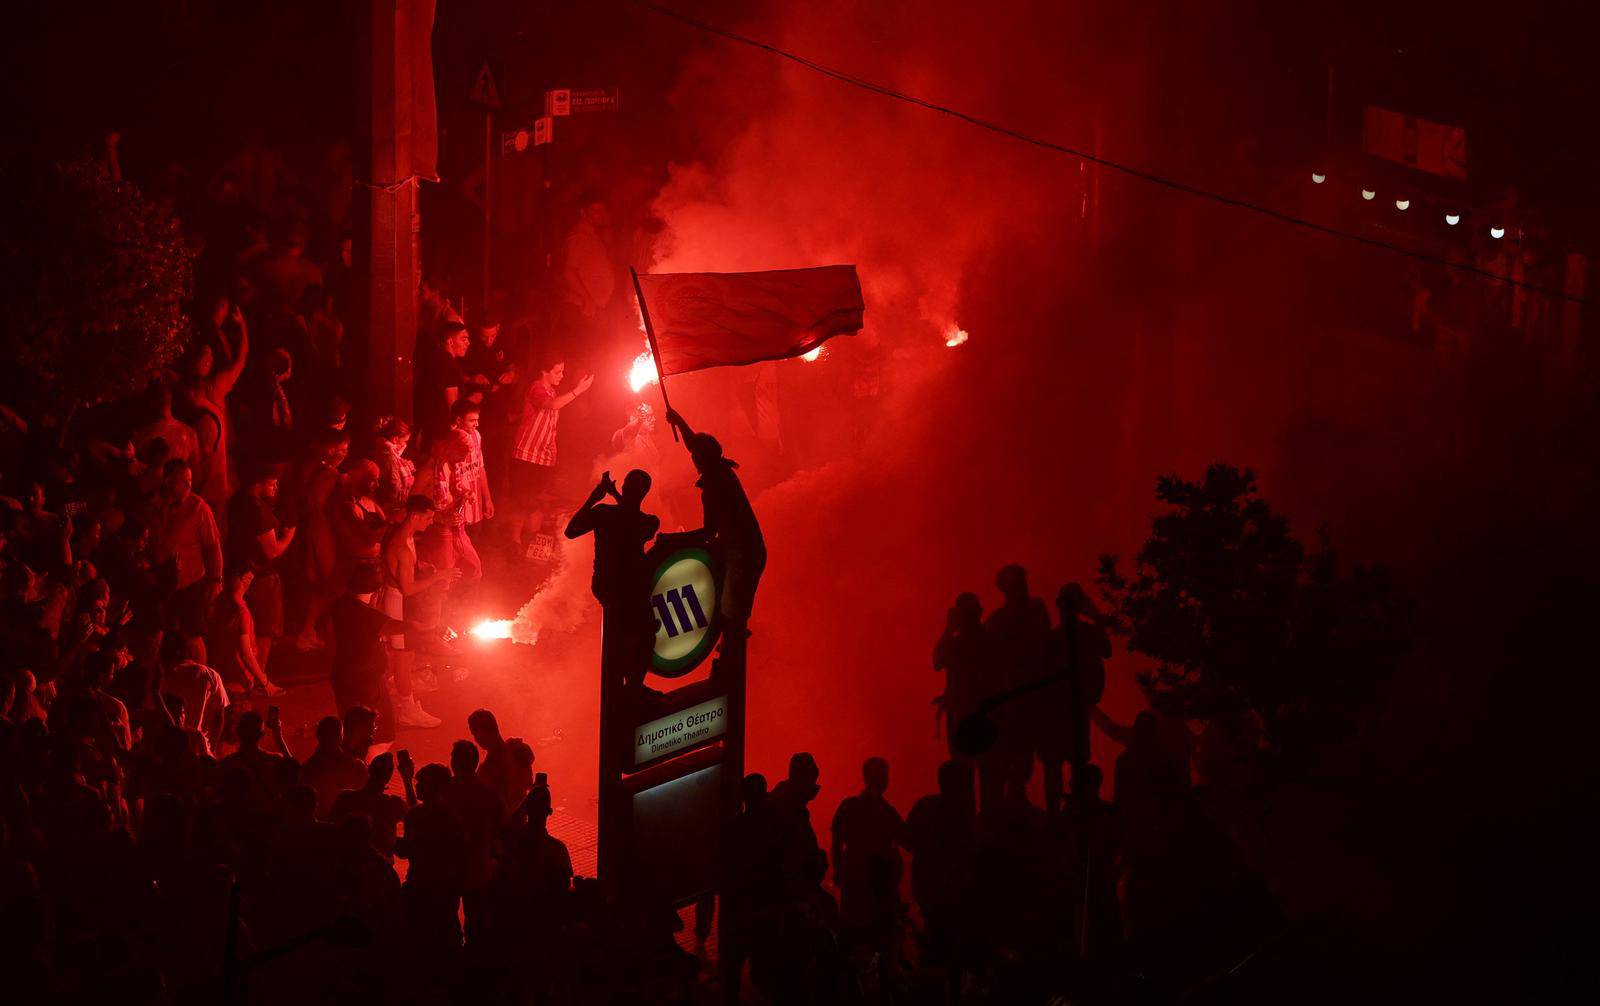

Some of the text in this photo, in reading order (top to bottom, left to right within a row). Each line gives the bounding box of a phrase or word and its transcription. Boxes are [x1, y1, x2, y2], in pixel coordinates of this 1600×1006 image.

[637, 706, 724, 747] Δημοτικό Θέατρο
[651, 726, 710, 753] Dimotiko Theatro
